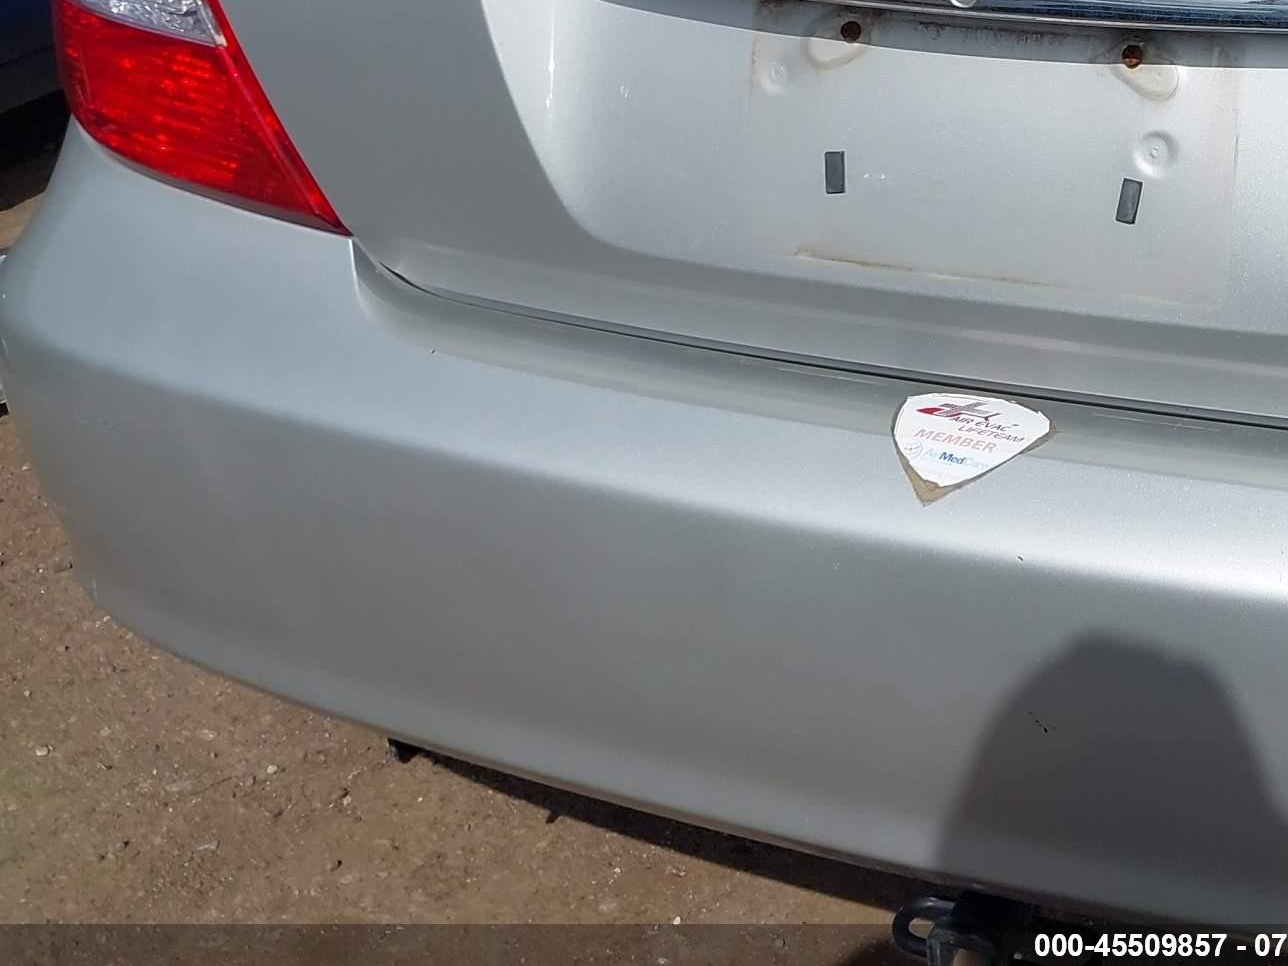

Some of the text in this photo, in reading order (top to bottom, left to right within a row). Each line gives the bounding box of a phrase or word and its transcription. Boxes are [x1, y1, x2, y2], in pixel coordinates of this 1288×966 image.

[949, 416, 1012, 432] AIR EVAC
[914, 428, 998, 454] MEMBER
[958, 425, 1025, 443] LIFETEAM
